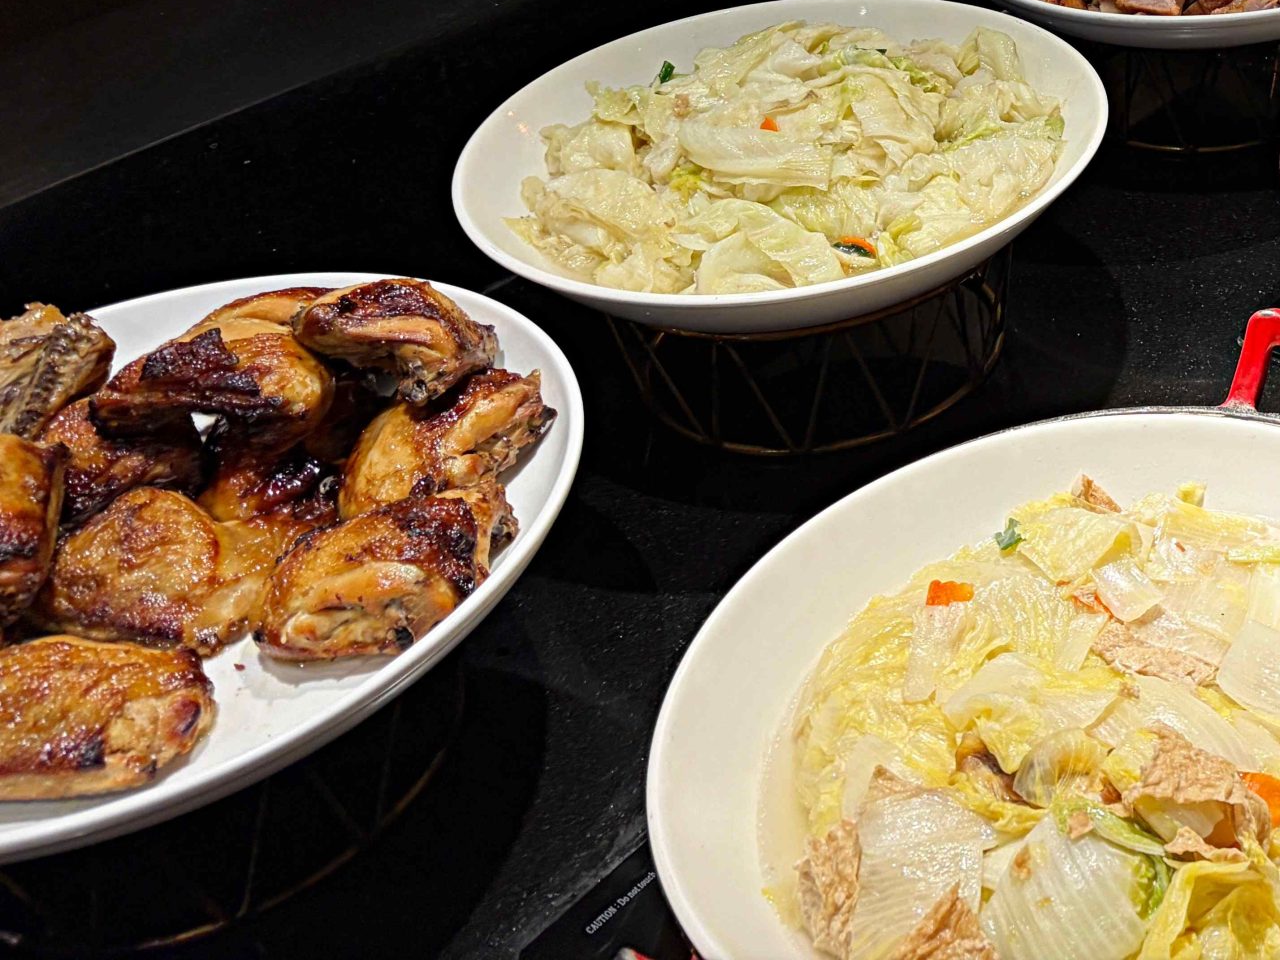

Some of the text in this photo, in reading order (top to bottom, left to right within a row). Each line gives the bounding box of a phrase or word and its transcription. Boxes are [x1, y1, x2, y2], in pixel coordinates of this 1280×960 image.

[585, 905, 618, 934] CAUTION
[616, 896, 630, 907] Do
[627, 886, 641, 899] not
[637, 871, 656, 889] touch
